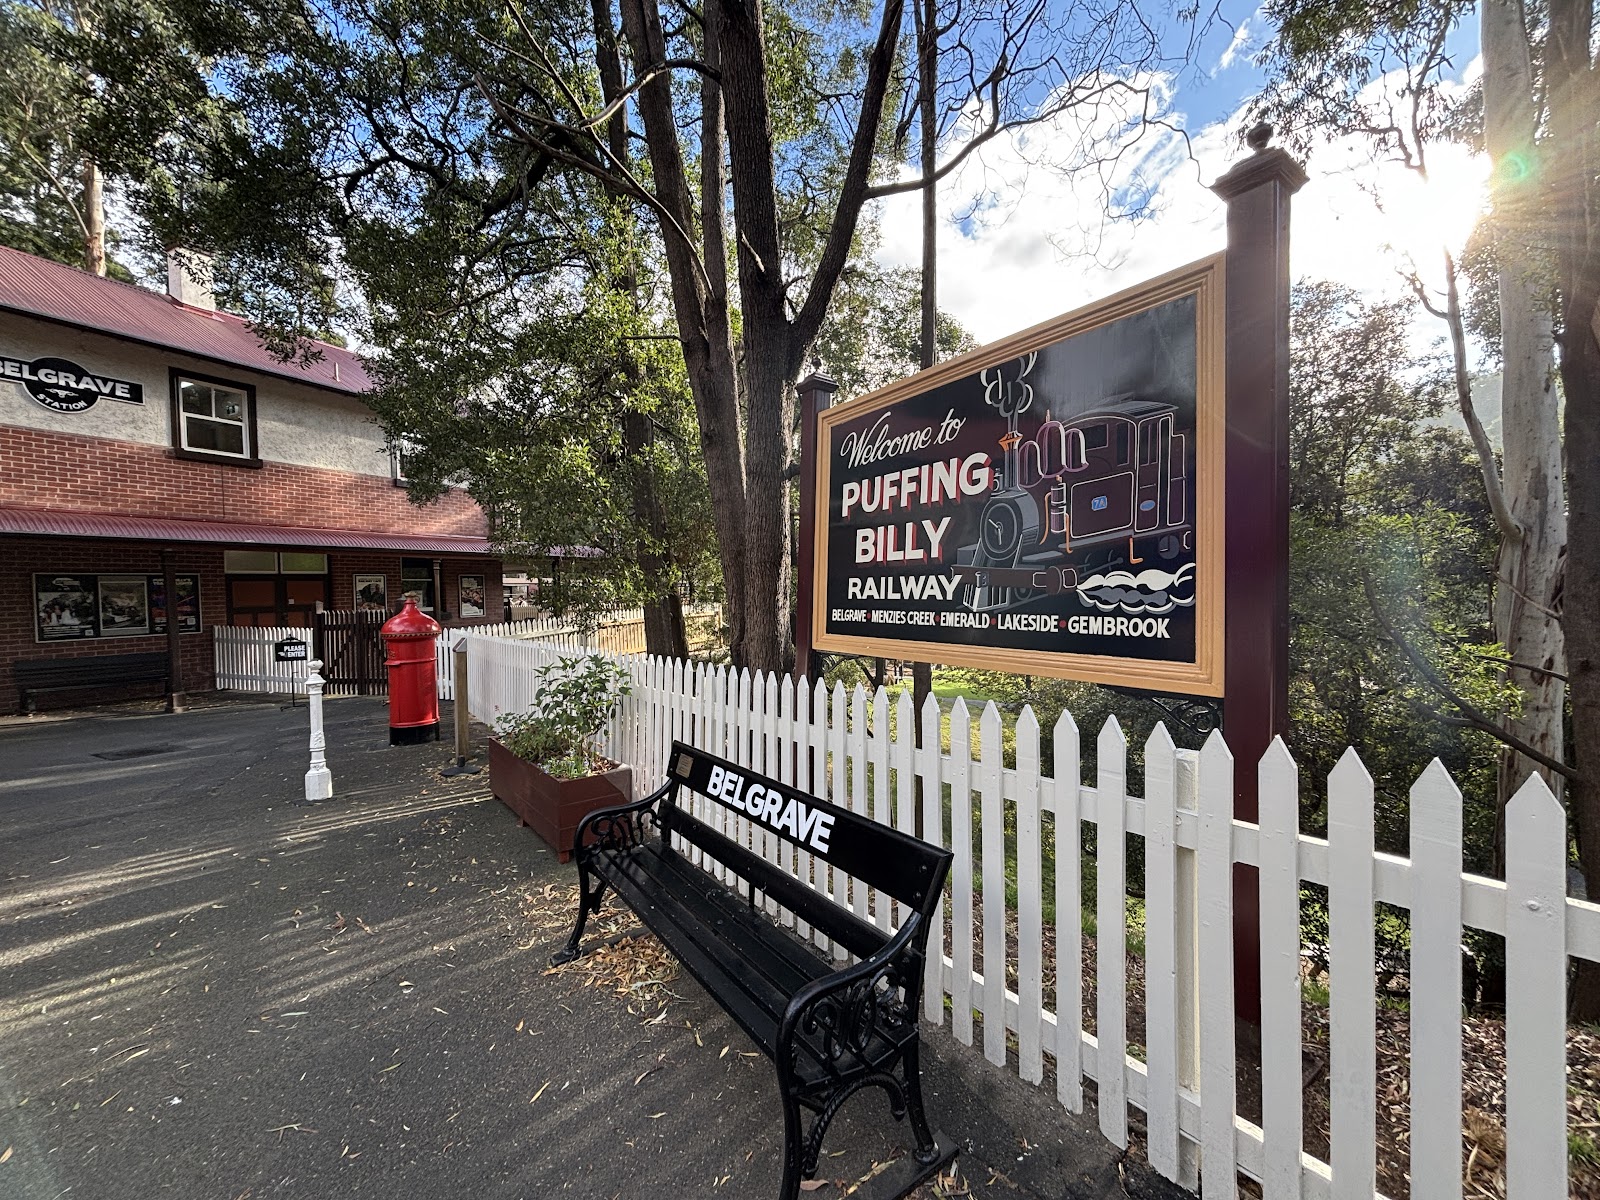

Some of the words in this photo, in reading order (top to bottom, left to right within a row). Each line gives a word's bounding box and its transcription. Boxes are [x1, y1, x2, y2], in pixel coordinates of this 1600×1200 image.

[0, 360, 131, 398] ELGRAVE
[36, 393, 88, 410] STATION
[840, 411, 932, 469] Welcome
[933, 408, 967, 445] to
[842, 452, 992, 519] PUFFING
[855, 516, 951, 564] BILLY
[847, 574, 963, 601] RAILWAY
[832, 608, 867, 622] BELGRAVE
[871, 609, 906, 624] MENZIES
[907, 611, 936, 626] CREEK
[940, 612, 990, 629] EMERALD
[997, 613, 1060, 633] LAKESIDE
[1067, 615, 1171, 639] GEMBROOK
[706, 764, 836, 854] BELGRAVE
